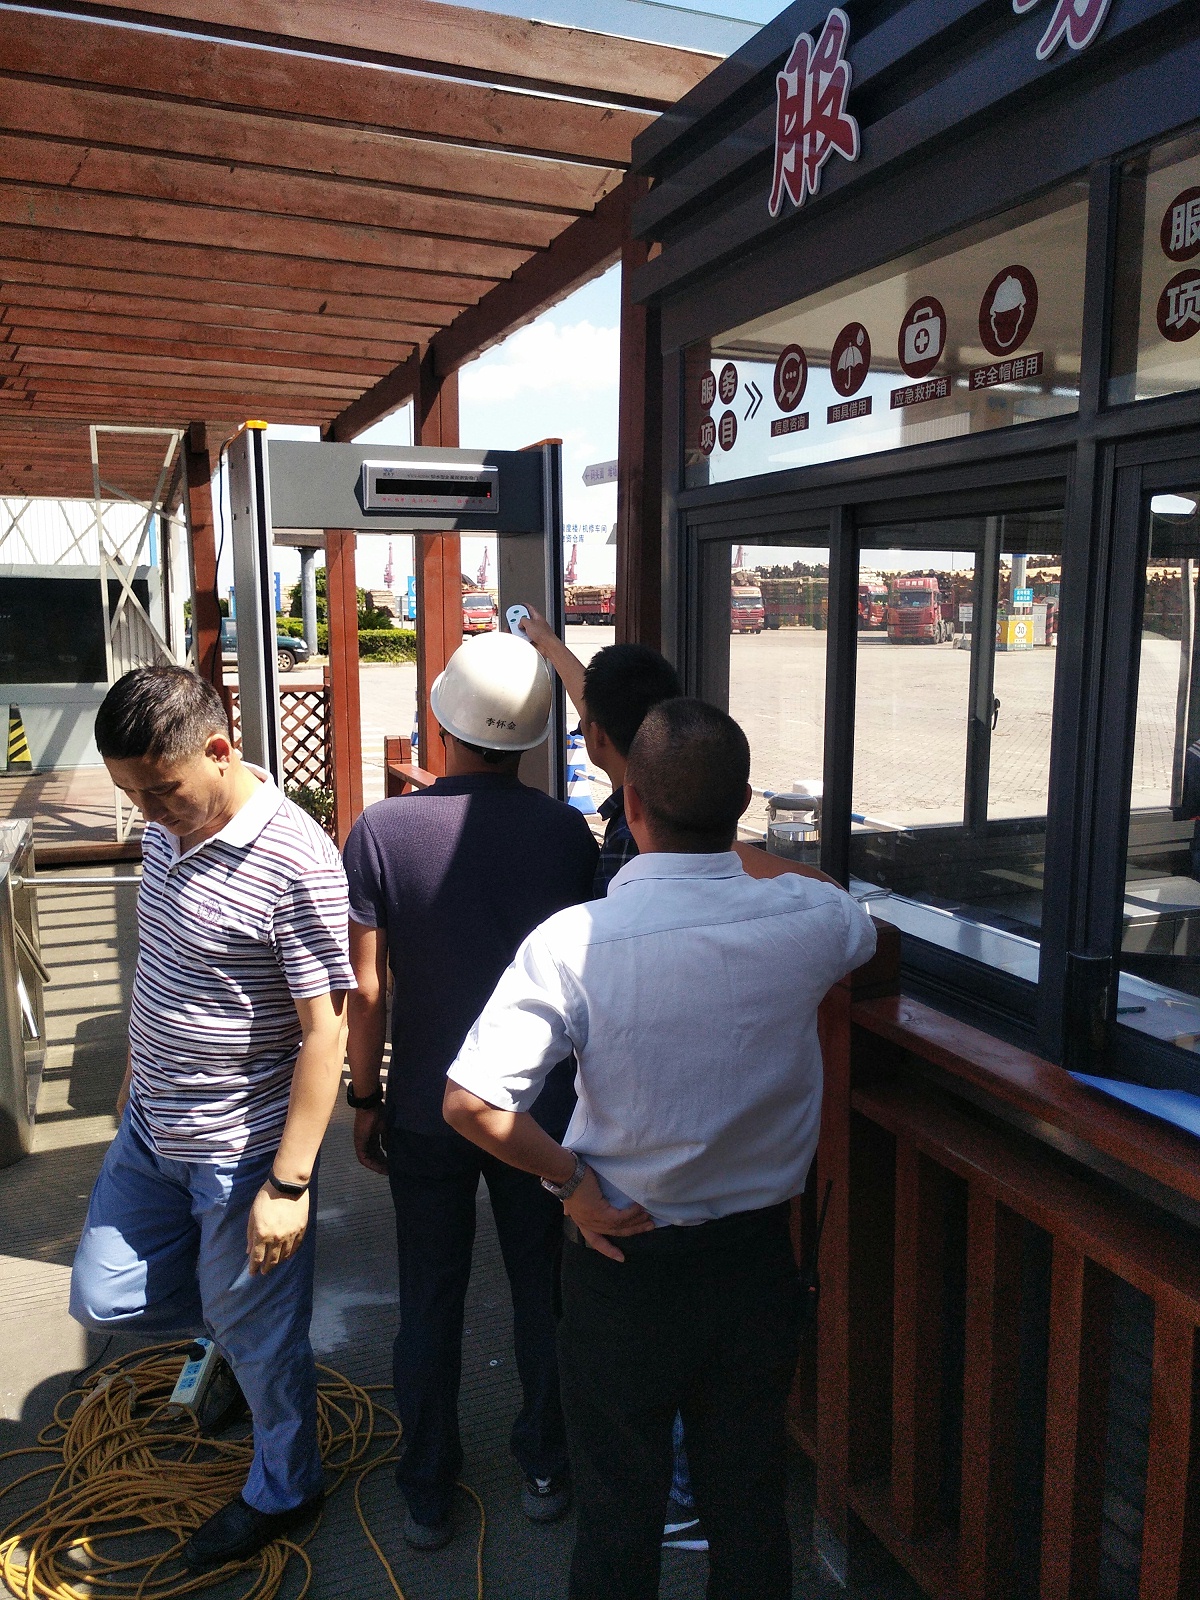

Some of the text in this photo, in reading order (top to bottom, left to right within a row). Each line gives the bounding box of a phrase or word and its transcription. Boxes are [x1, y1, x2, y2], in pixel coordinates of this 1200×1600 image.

[769, 8, 861, 217] 服
[973, 356, 1038, 388] 安全帽借用
[894, 379, 948, 407] 应急救护箱
[832, 399, 867, 421] 雨具借用
[774, 415, 806, 434] 信息咨询
